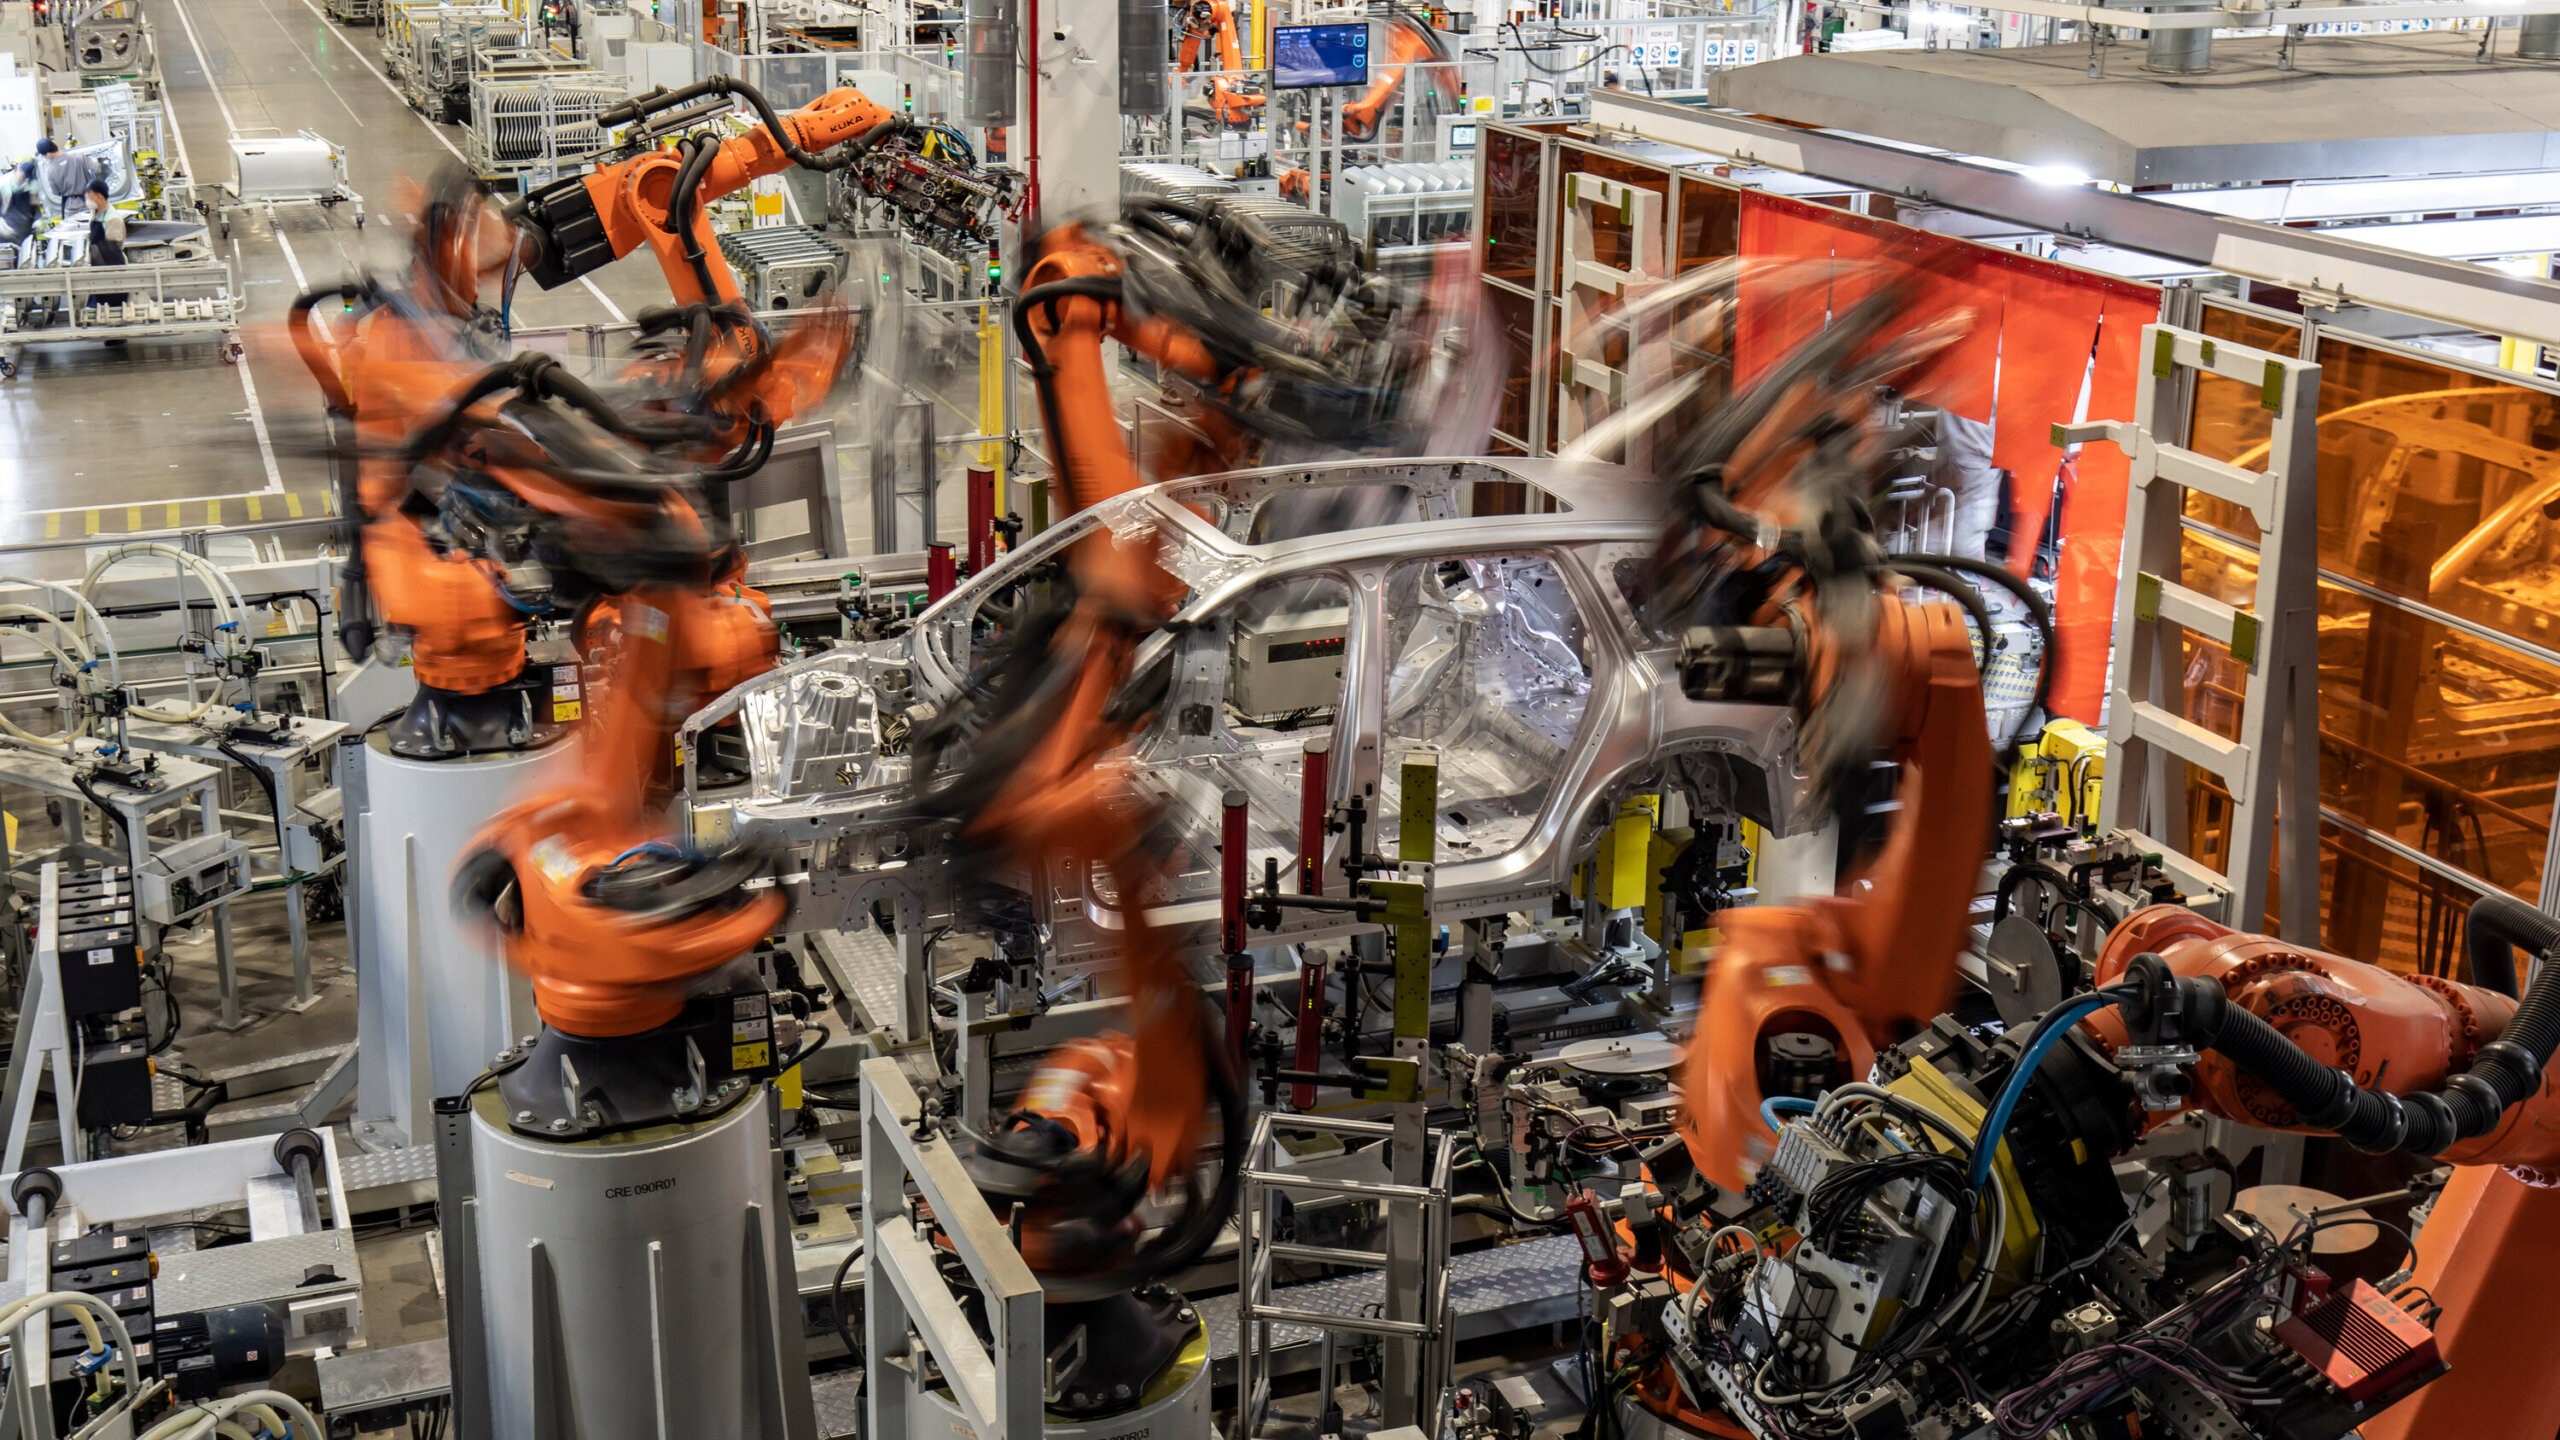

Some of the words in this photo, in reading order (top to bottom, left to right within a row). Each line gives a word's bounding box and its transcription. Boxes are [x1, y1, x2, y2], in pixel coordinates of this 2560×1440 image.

[829, 115, 864, 134] KUKA
[738, 327, 755, 356] KUK
[604, 1186, 633, 1199] CRE
[634, 1177, 676, 1196] 090R01
[1109, 1427, 1150, 1440] 0R03
